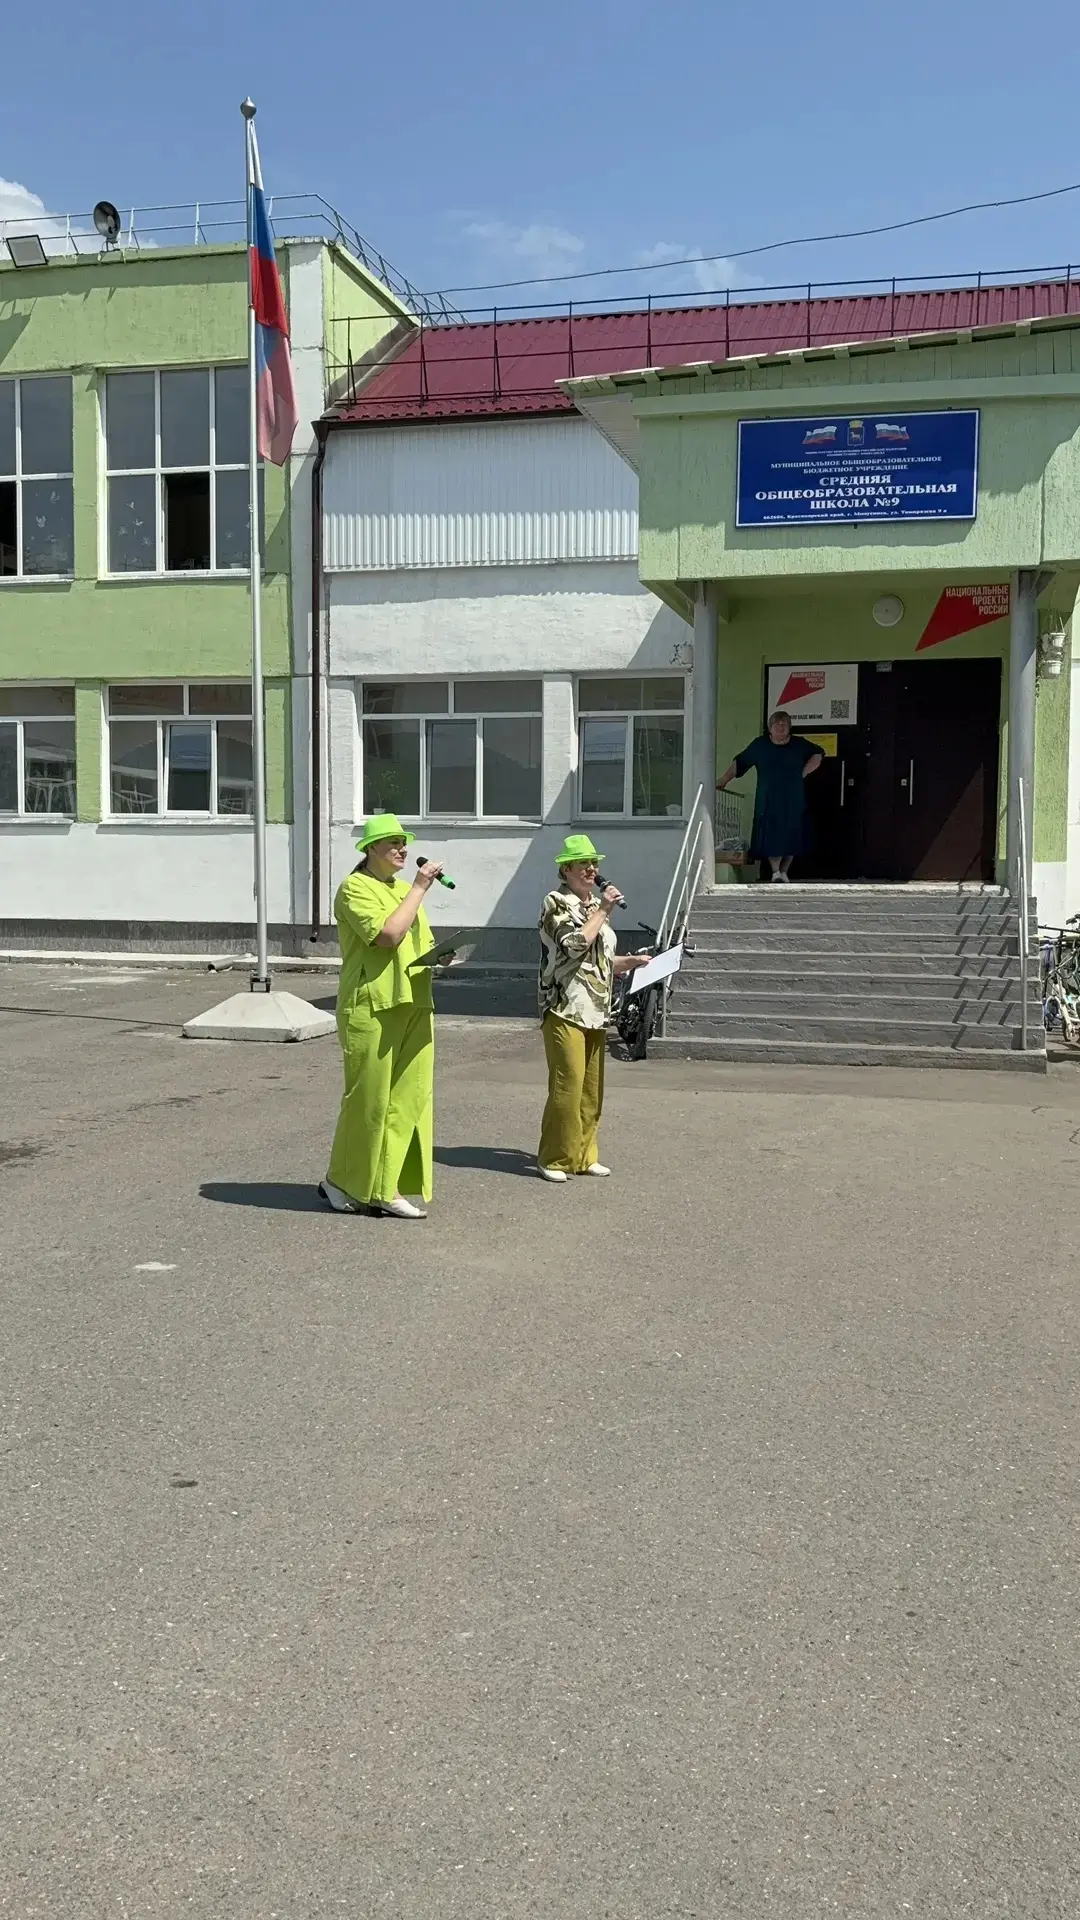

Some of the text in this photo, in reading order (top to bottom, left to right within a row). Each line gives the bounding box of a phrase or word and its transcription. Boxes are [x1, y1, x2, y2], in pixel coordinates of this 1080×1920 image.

[771, 456, 942, 469] МУНИЦИПАЛЬНОЕ ОБЩЕОБРАЗОВАТЕЛЬНОЕ
[803, 464, 908, 474] БЮДЖЕТНОЕ УЧРЕЖДЕНИЕ
[819, 475, 892, 487] СРЕДНЯЯ
[755, 483, 958, 502] ОБЩЕОБРАЗОВАТЕЛЬНАЯ
[809, 497, 900, 510] ШКОЛА №9
[945, 585, 1009, 597] НАЦИОНАЛЬНЫЕ
[972, 595, 1009, 605] ПРОЕКТЫ
[978, 605, 1009, 615] РОССИИ
